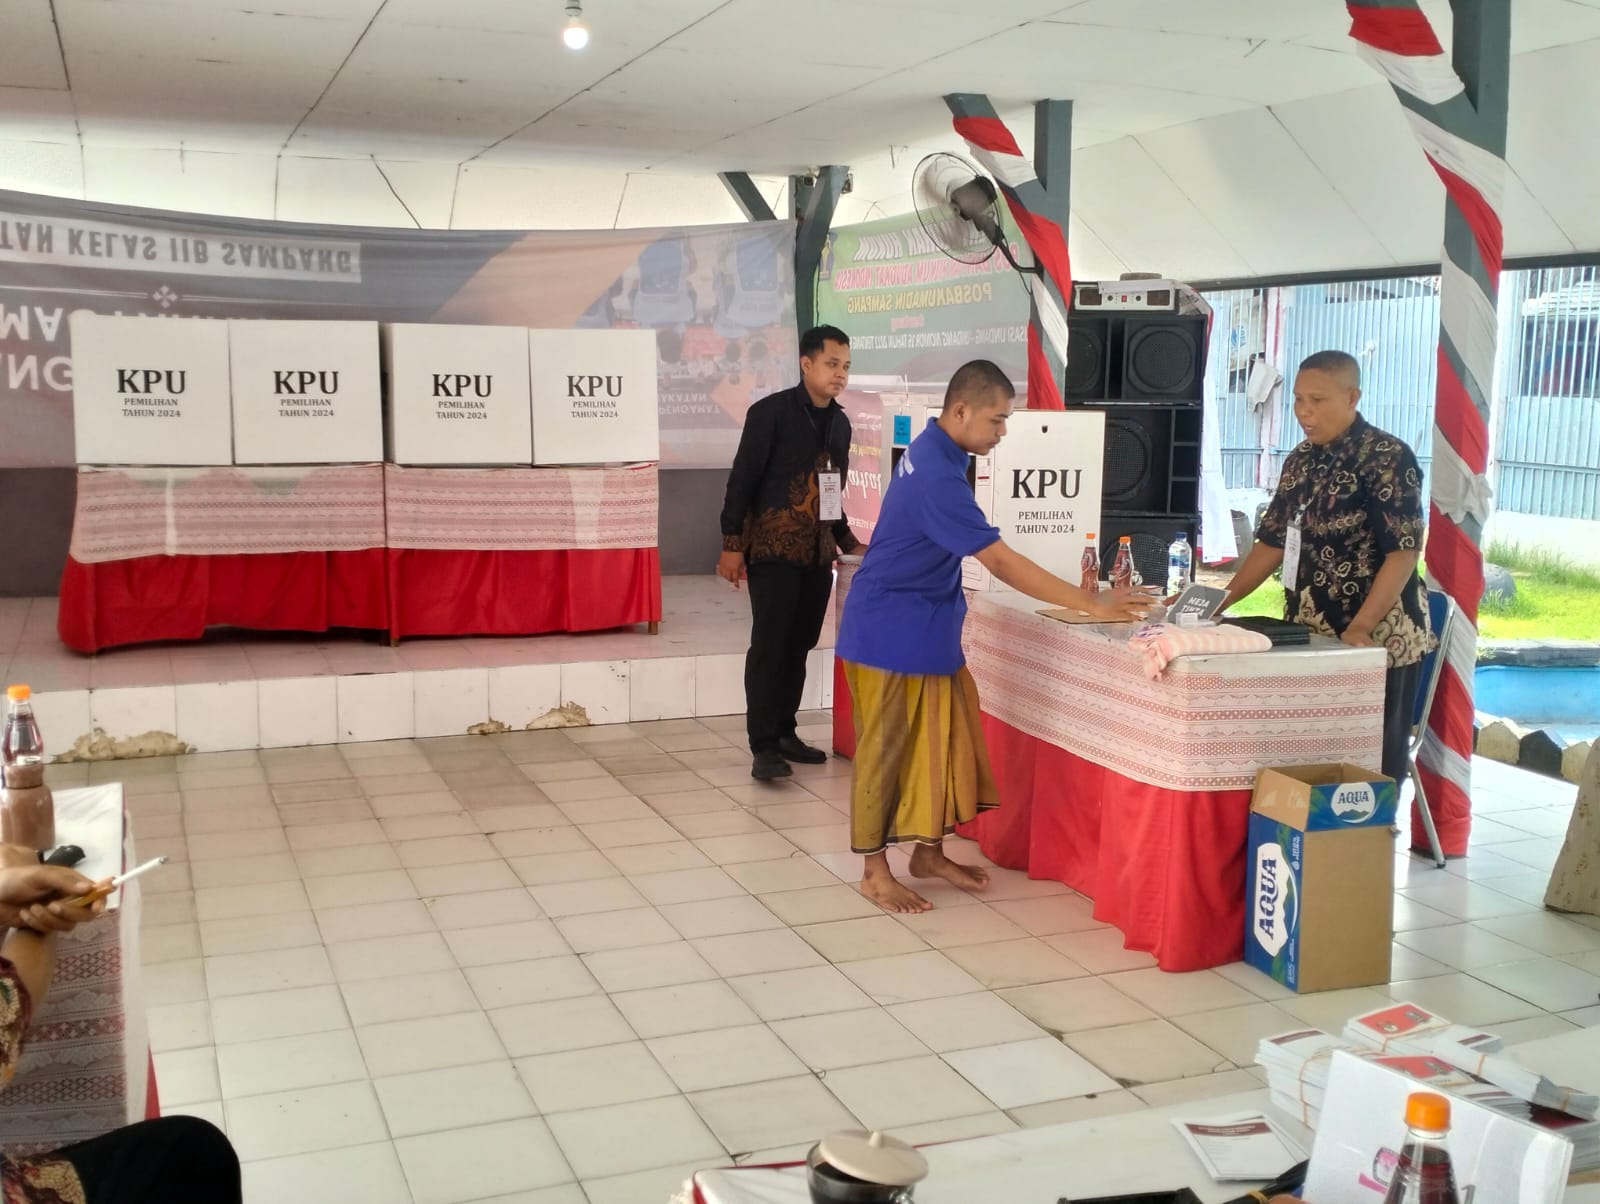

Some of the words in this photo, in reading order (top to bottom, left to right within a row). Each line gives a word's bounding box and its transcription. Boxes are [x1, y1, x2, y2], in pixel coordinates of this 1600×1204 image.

[117, 369, 187, 394] KPU
[273, 371, 339, 394] KPU
[432, 374, 493, 398] KPU
[567, 375, 623, 398] KPU
[124, 398, 178, 406] PEMILIHAN
[438, 401, 485, 409] PEMILIHAN
[573, 401, 616, 409] PEMILIHAN
[122, 409, 155, 417] TAHUN
[157, 409, 181, 417] 2024
[279, 409, 309, 417] TAHUN
[312, 409, 334, 417] 2024
[436, 411, 465, 419] TAHUN
[467, 411, 487, 420] 2024
[1011, 469, 1082, 499] KPU
[1018, 511, 1073, 520] PEMILIHAN
[1015, 525, 1048, 534] TAHUN
[1050, 524, 1076, 534] 2024
[1338, 791, 1369, 805] AQUA
[1259, 857, 1279, 940] AQUA
